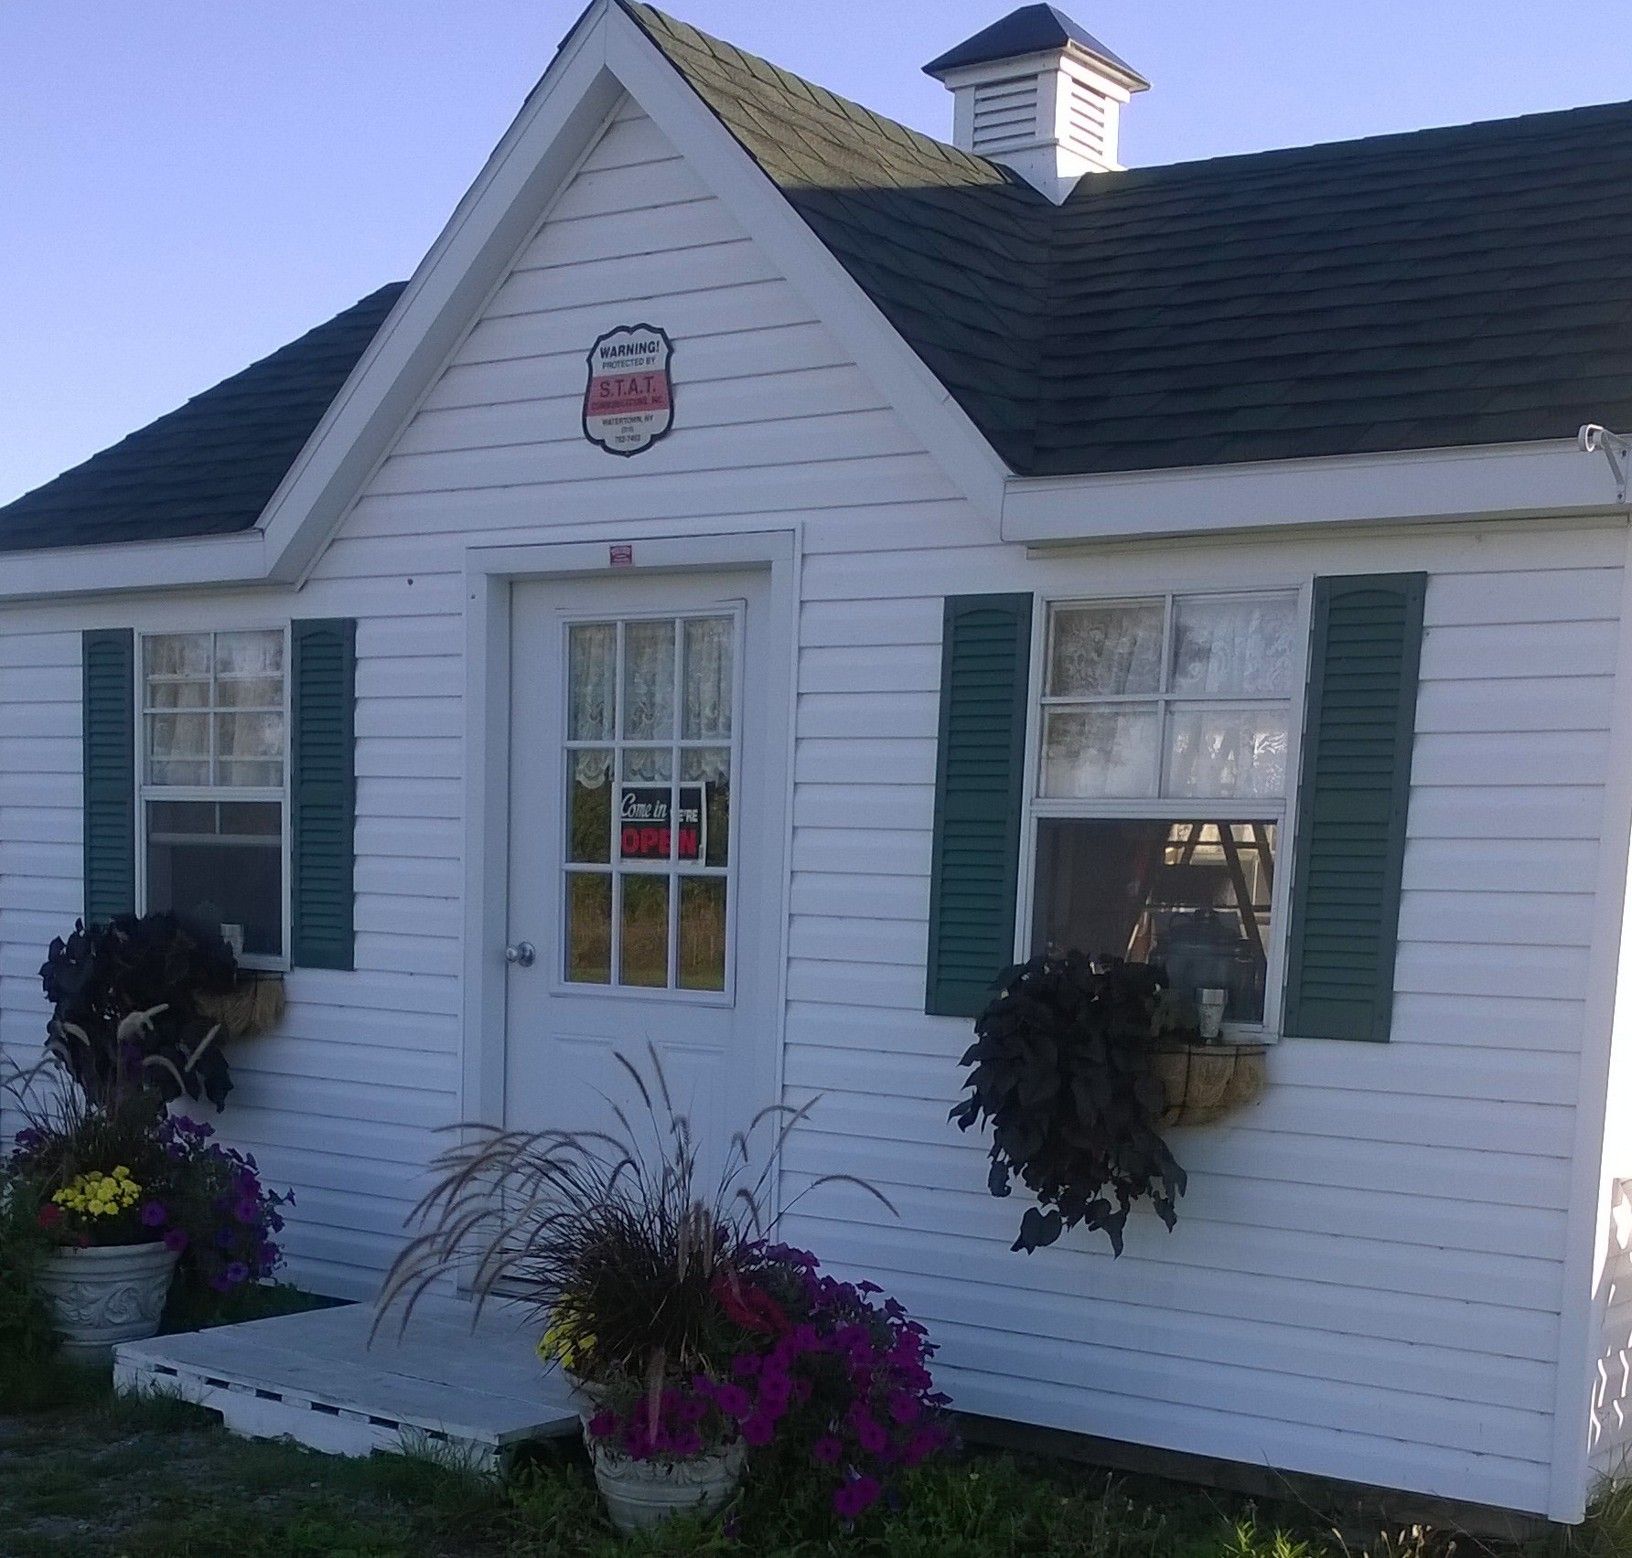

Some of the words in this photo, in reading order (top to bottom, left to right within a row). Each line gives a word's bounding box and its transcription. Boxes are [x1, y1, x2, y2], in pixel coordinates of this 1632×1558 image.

[600, 341, 660, 359] WARNING!
[602, 357, 645, 369] PROTECTED
[646, 356, 656, 365] BY
[600, 376, 656, 398] S.T.A.T.
[621, 793, 652, 818] Come
[654, 800, 668, 818] in
[622, 827, 698, 855] OPEN
